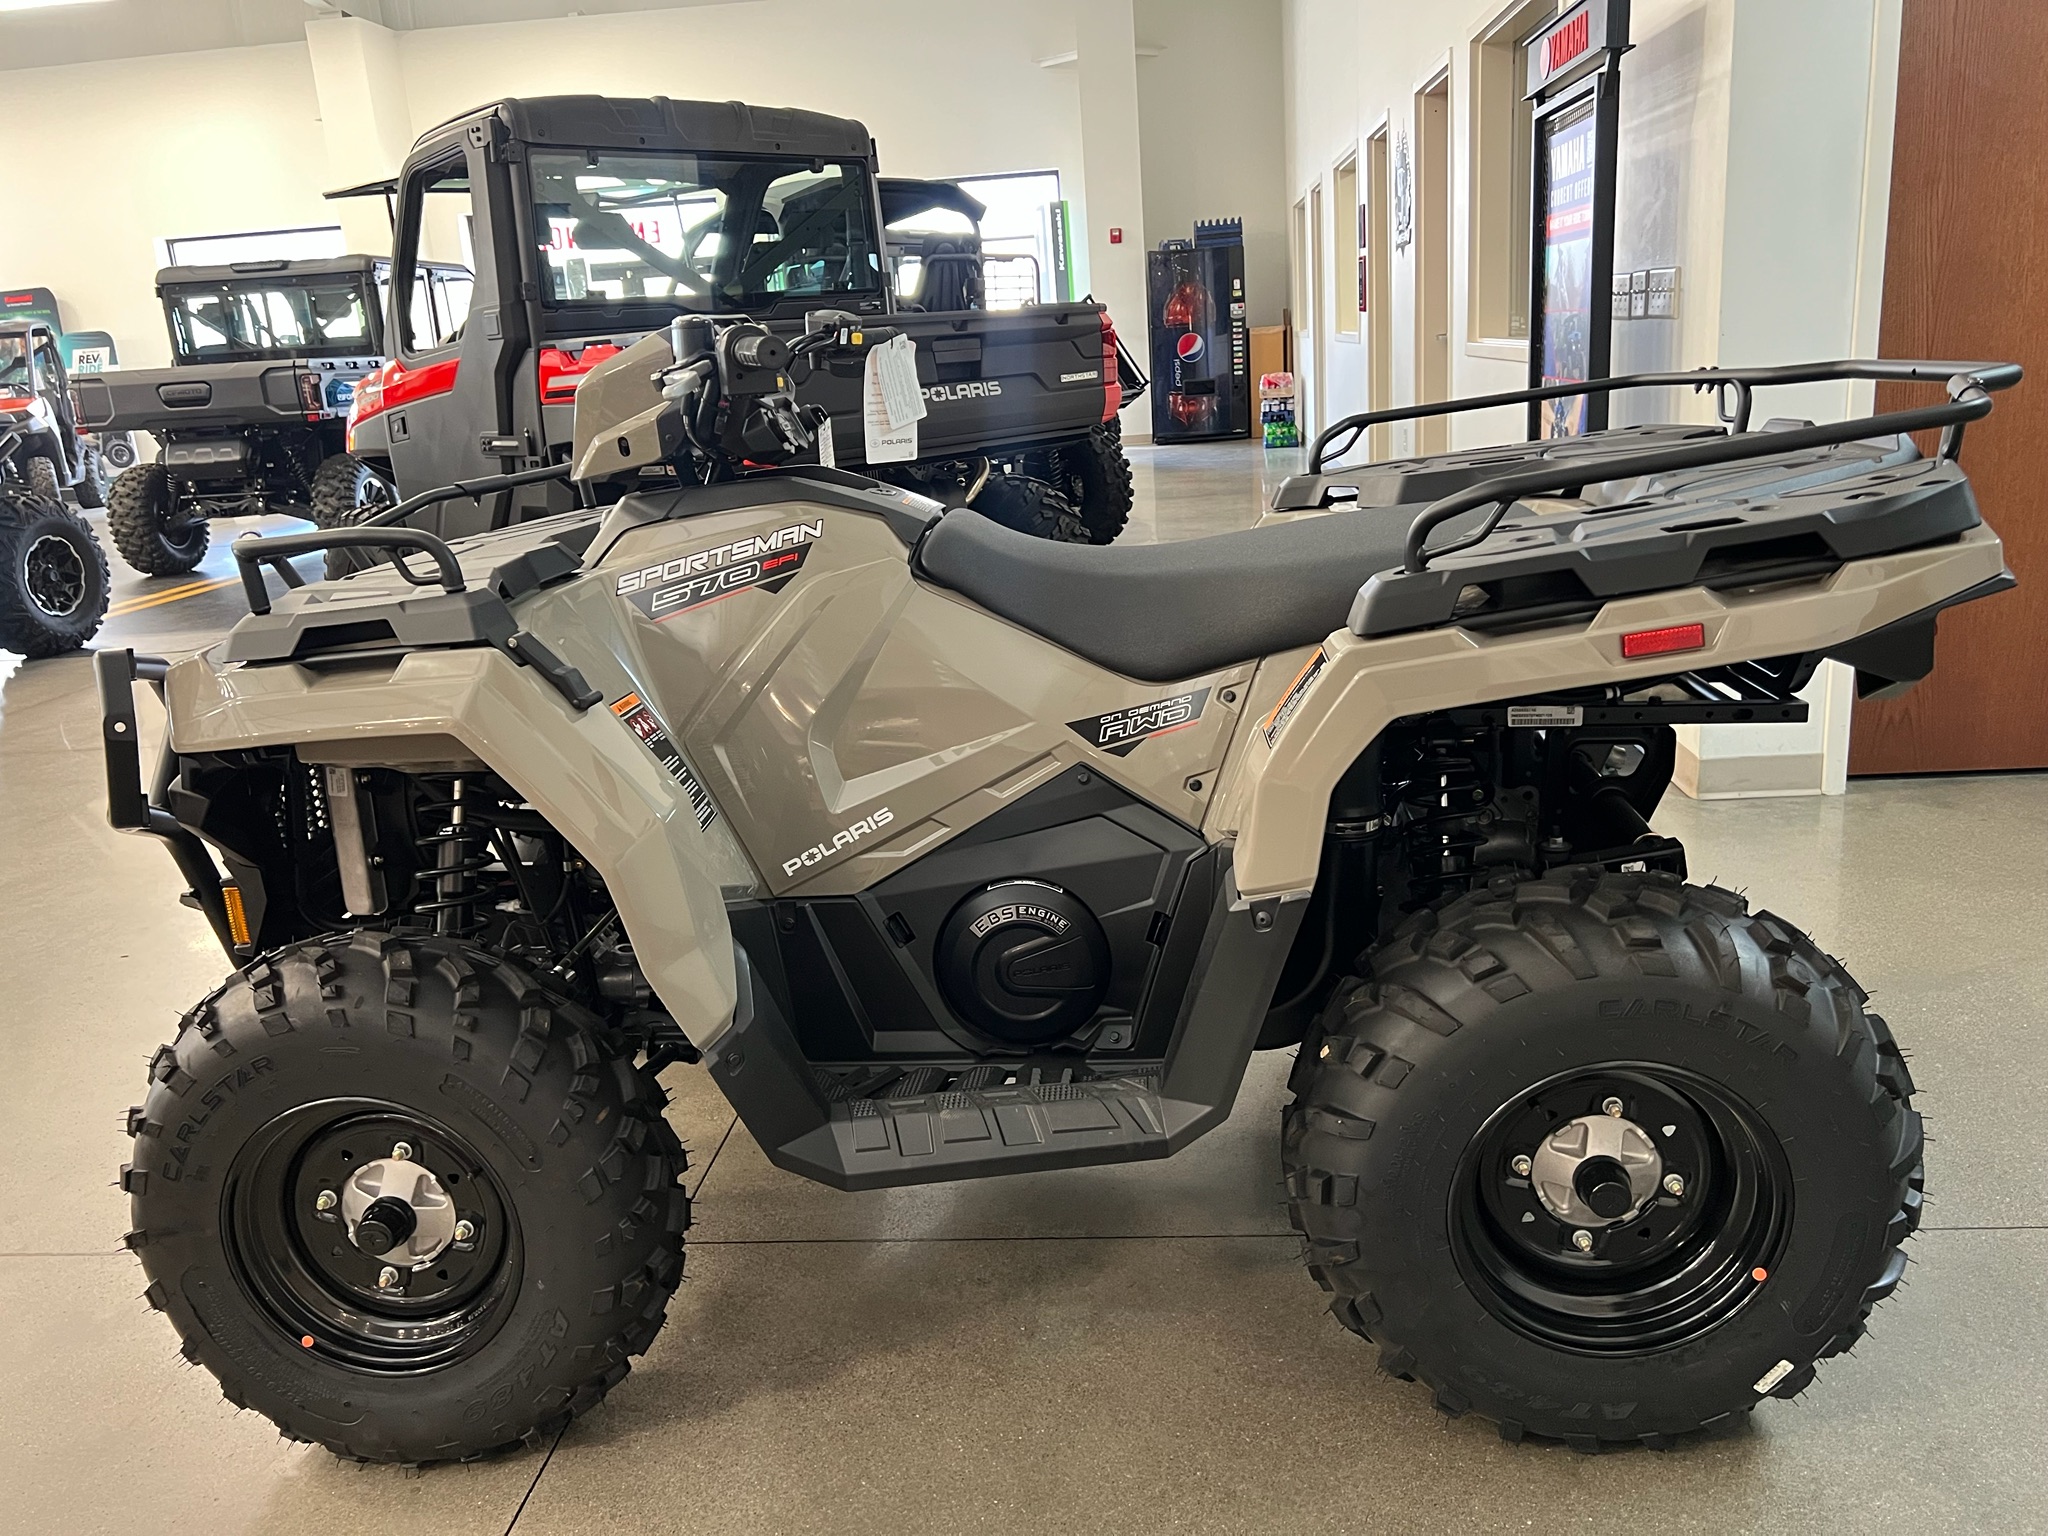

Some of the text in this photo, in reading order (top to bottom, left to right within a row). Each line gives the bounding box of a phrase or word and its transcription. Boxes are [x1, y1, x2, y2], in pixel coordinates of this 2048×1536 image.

[1551, 10, 1588, 72] YAMAHA
[1551, 134, 1585, 182] YAMAHA
[1551, 183, 1573, 208] CURRENT
[1054, 208, 1065, 270] Kawasaki
[78, 353, 100, 364] REV
[1174, 359, 1182, 387] pepsi
[881, 438, 913, 446] POLARIS
[616, 519, 823, 596] SPORTSMAN
[651, 552, 799, 612] 570 EFI
[1099, 704, 1192, 742] AWD
[1101, 695, 1192, 724] ON DEMAND
[782, 806, 894, 877] POLARIS
[975, 906, 1068, 933] EBS ENGINE
[1013, 962, 1072, 978] POLARIS
[1597, 997, 1799, 1064] CARLSTAR
[161, 1054, 276, 1182] CARLSTAR
[463, 1306, 569, 1421] AT489
